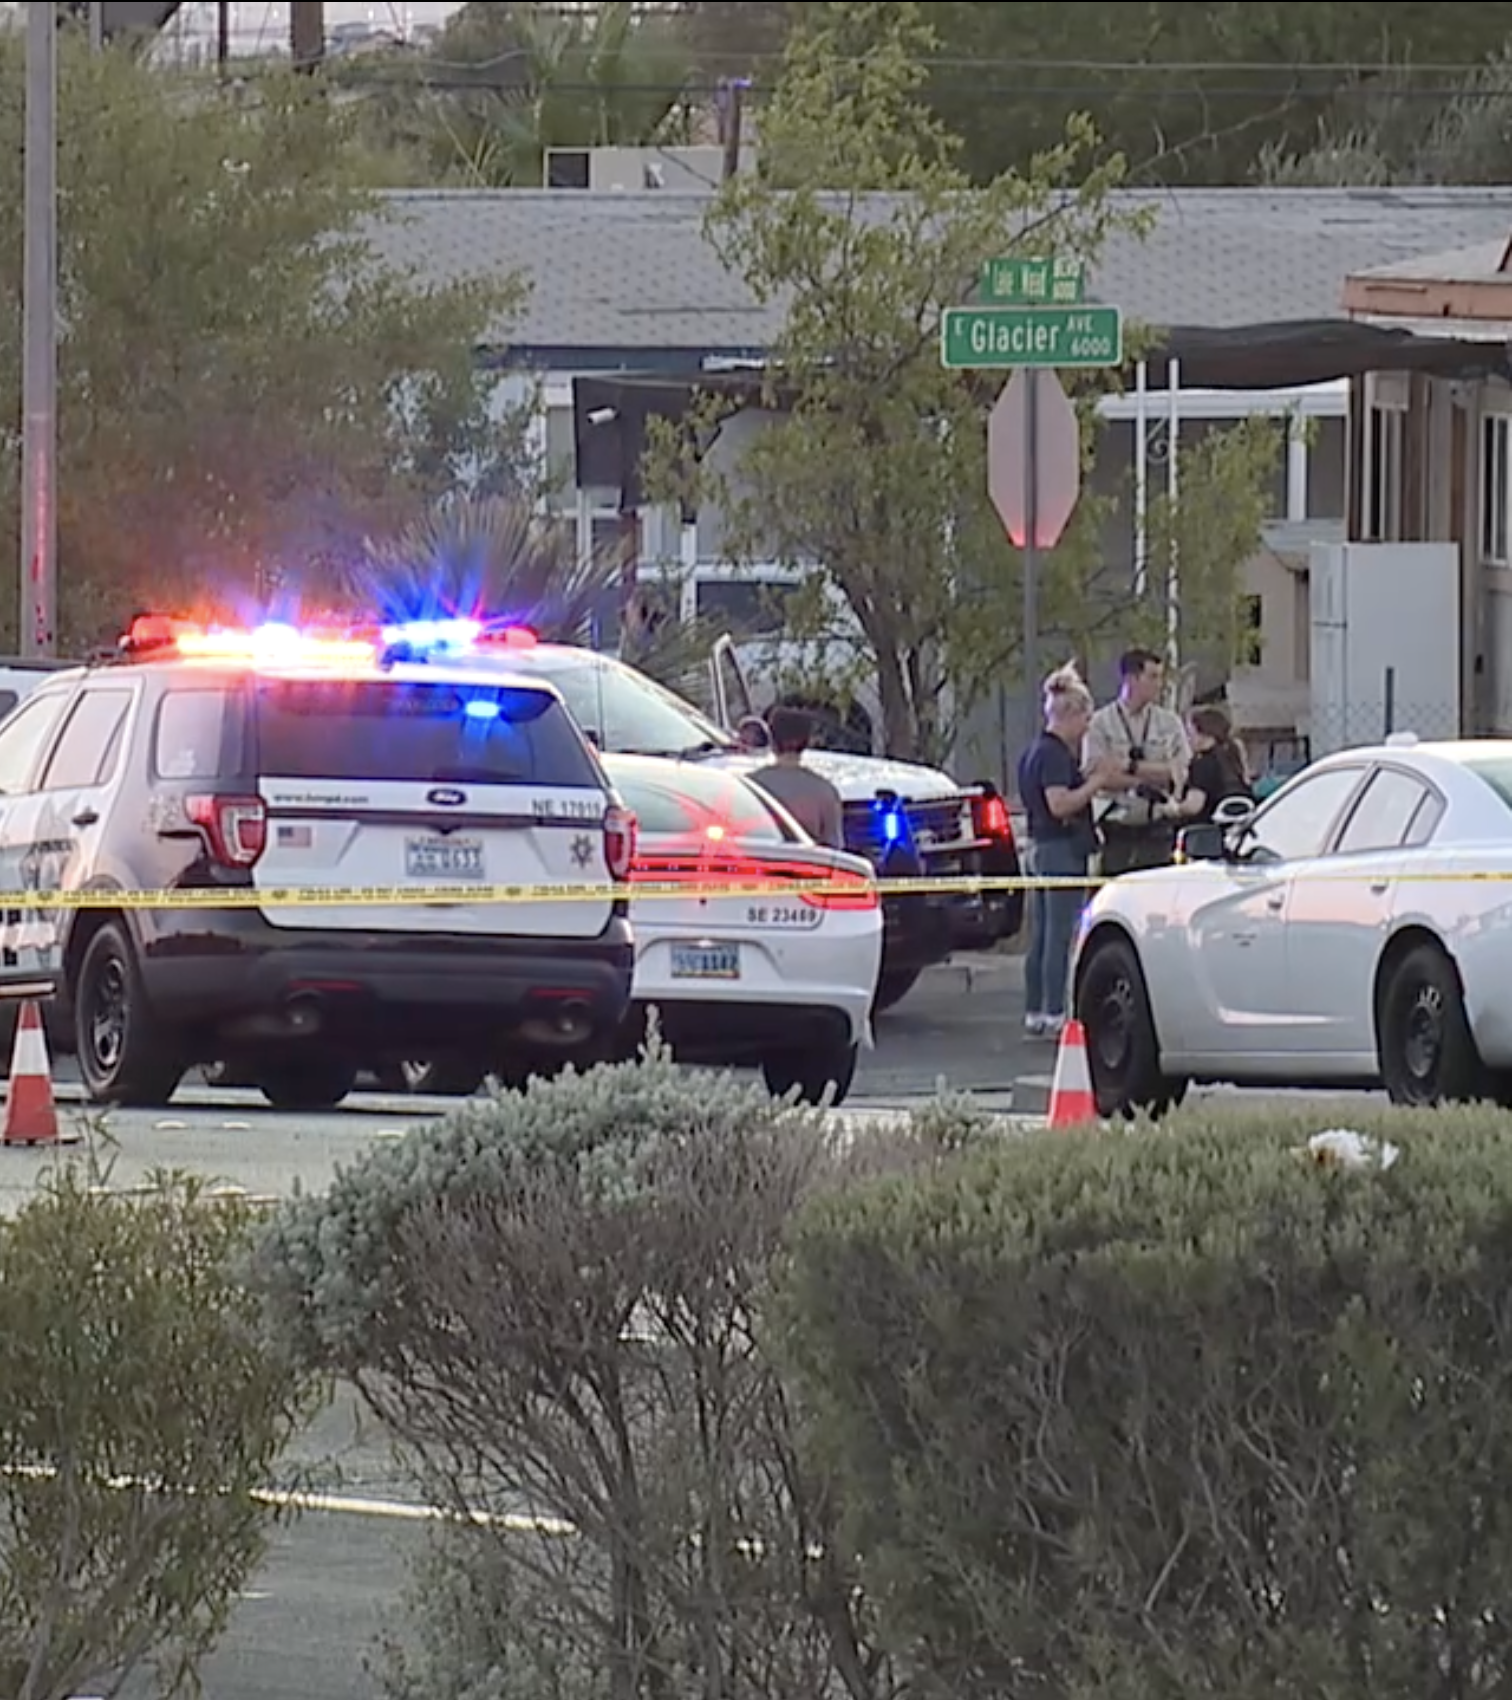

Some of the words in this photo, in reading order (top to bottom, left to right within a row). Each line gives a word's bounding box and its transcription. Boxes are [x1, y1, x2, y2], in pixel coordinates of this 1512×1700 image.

[954, 317, 965, 337] E
[971, 318, 1059, 352] Glacier
[1066, 316, 1094, 332] AVE
[1071, 337, 1112, 357] 6000
